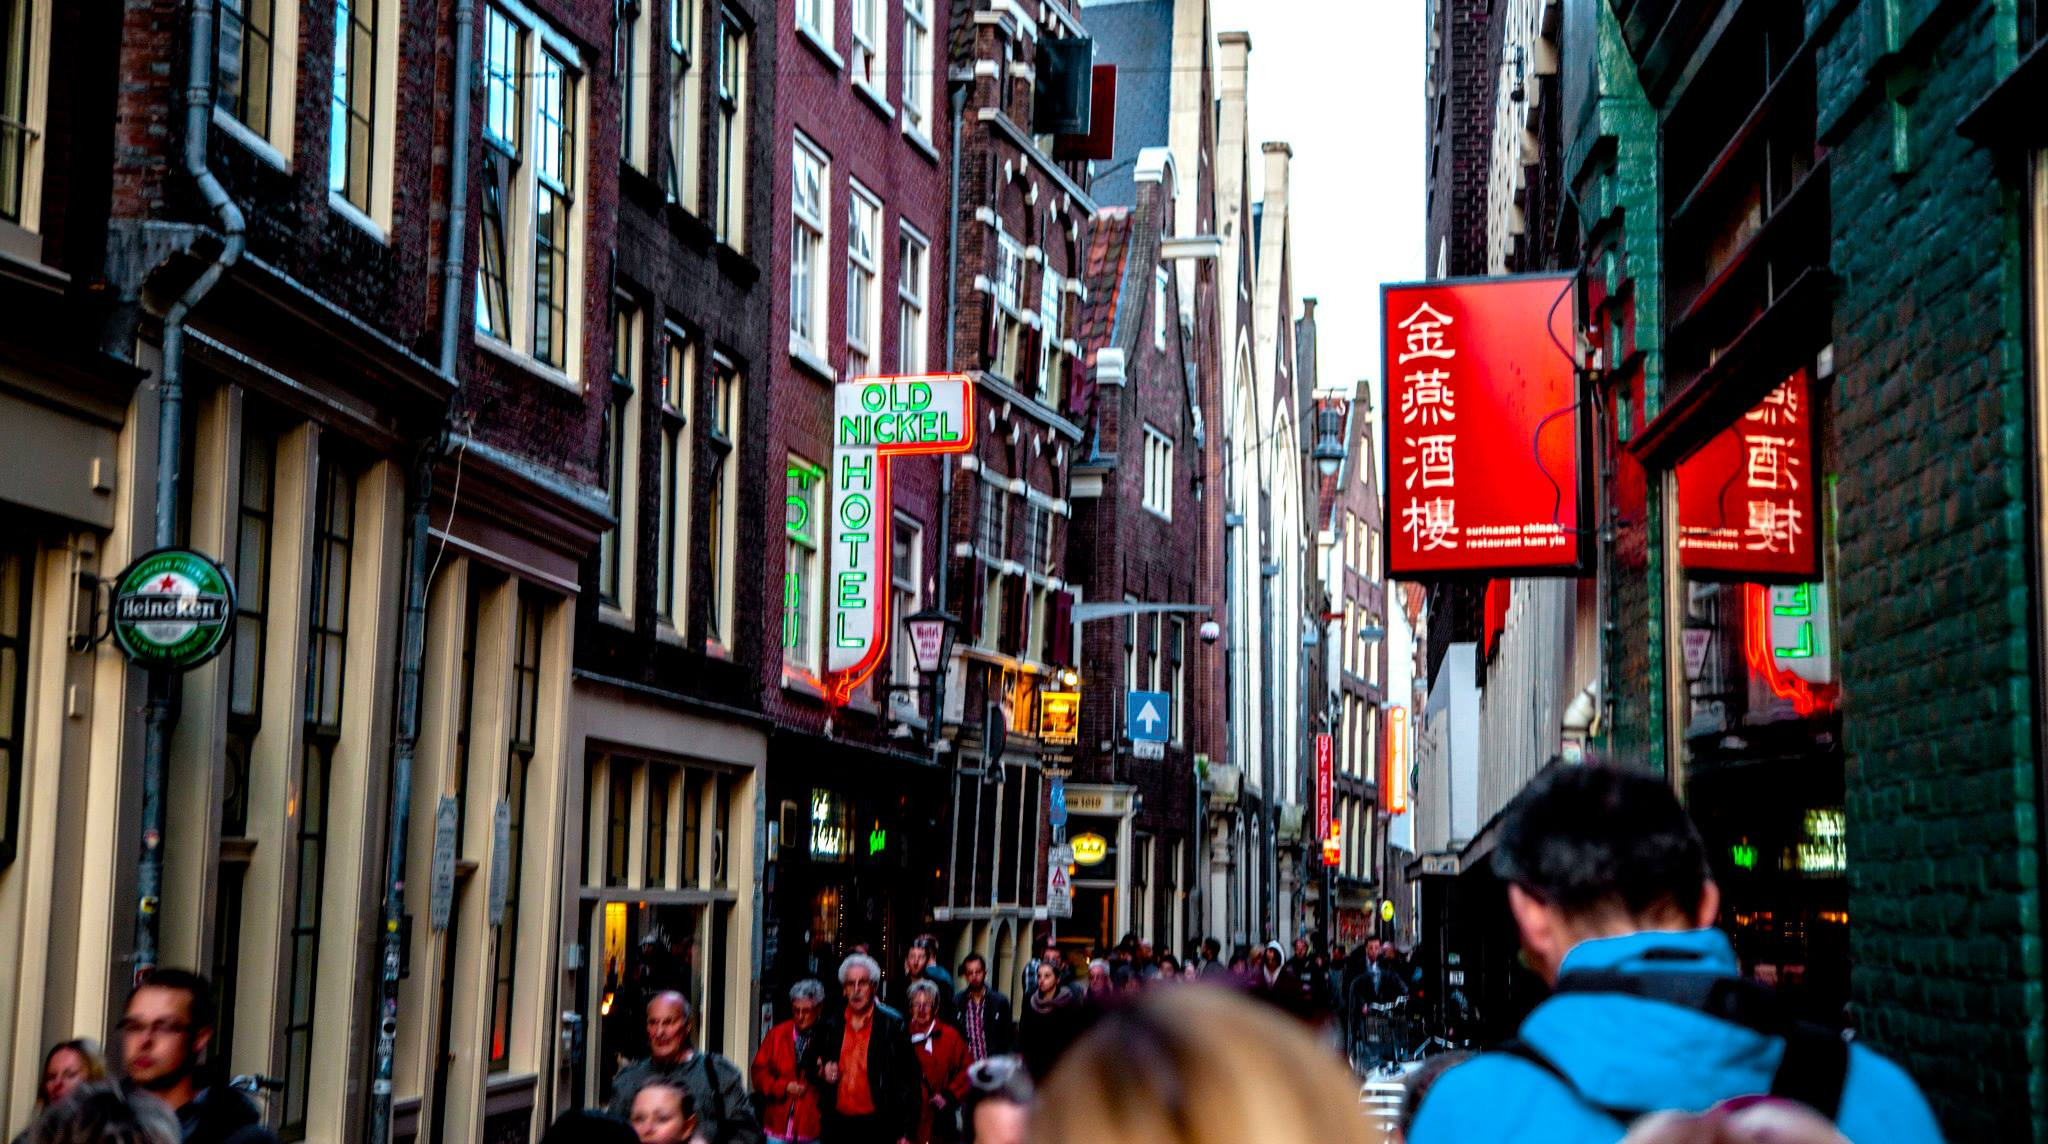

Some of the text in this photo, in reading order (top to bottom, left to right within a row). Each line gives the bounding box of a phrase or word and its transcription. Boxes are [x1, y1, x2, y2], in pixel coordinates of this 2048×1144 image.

[861, 382, 932, 412] OLD
[840, 411, 959, 445] NICKEL
[1398, 301, 1459, 553] 金燕酒樓
[836, 455, 873, 648] HOTEL
[1466, 537, 1521, 549] restaurant
[1549, 534, 1566, 548] yin
[122, 597, 216, 618] Heineken
